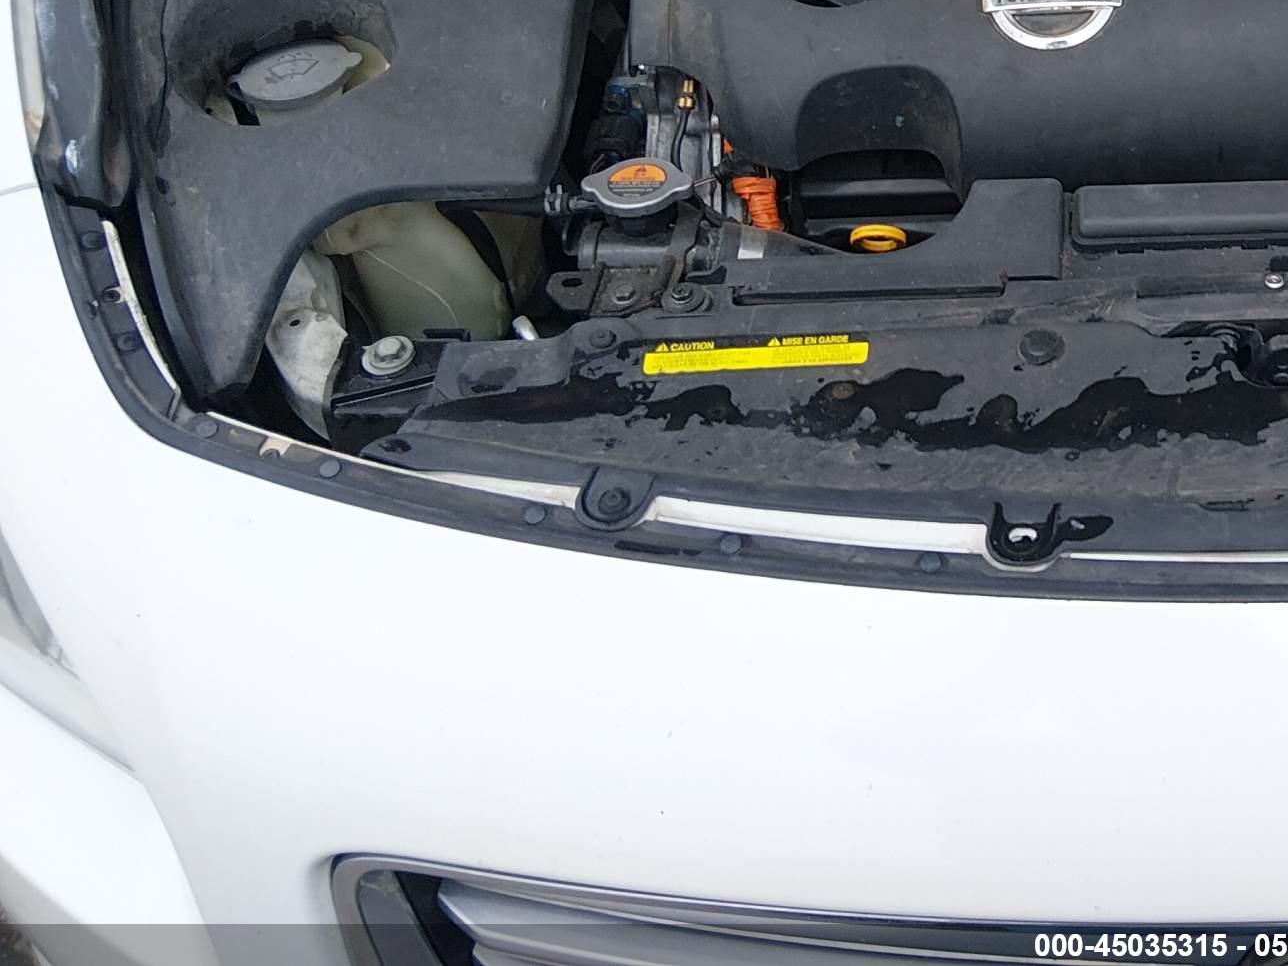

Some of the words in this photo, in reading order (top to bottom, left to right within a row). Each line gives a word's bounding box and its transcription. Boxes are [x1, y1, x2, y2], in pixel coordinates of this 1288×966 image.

[782, 336, 804, 346] MISE
[804, 336, 818, 345] EN
[818, 334, 849, 344] GARDE
[670, 341, 715, 352] CAUTION
